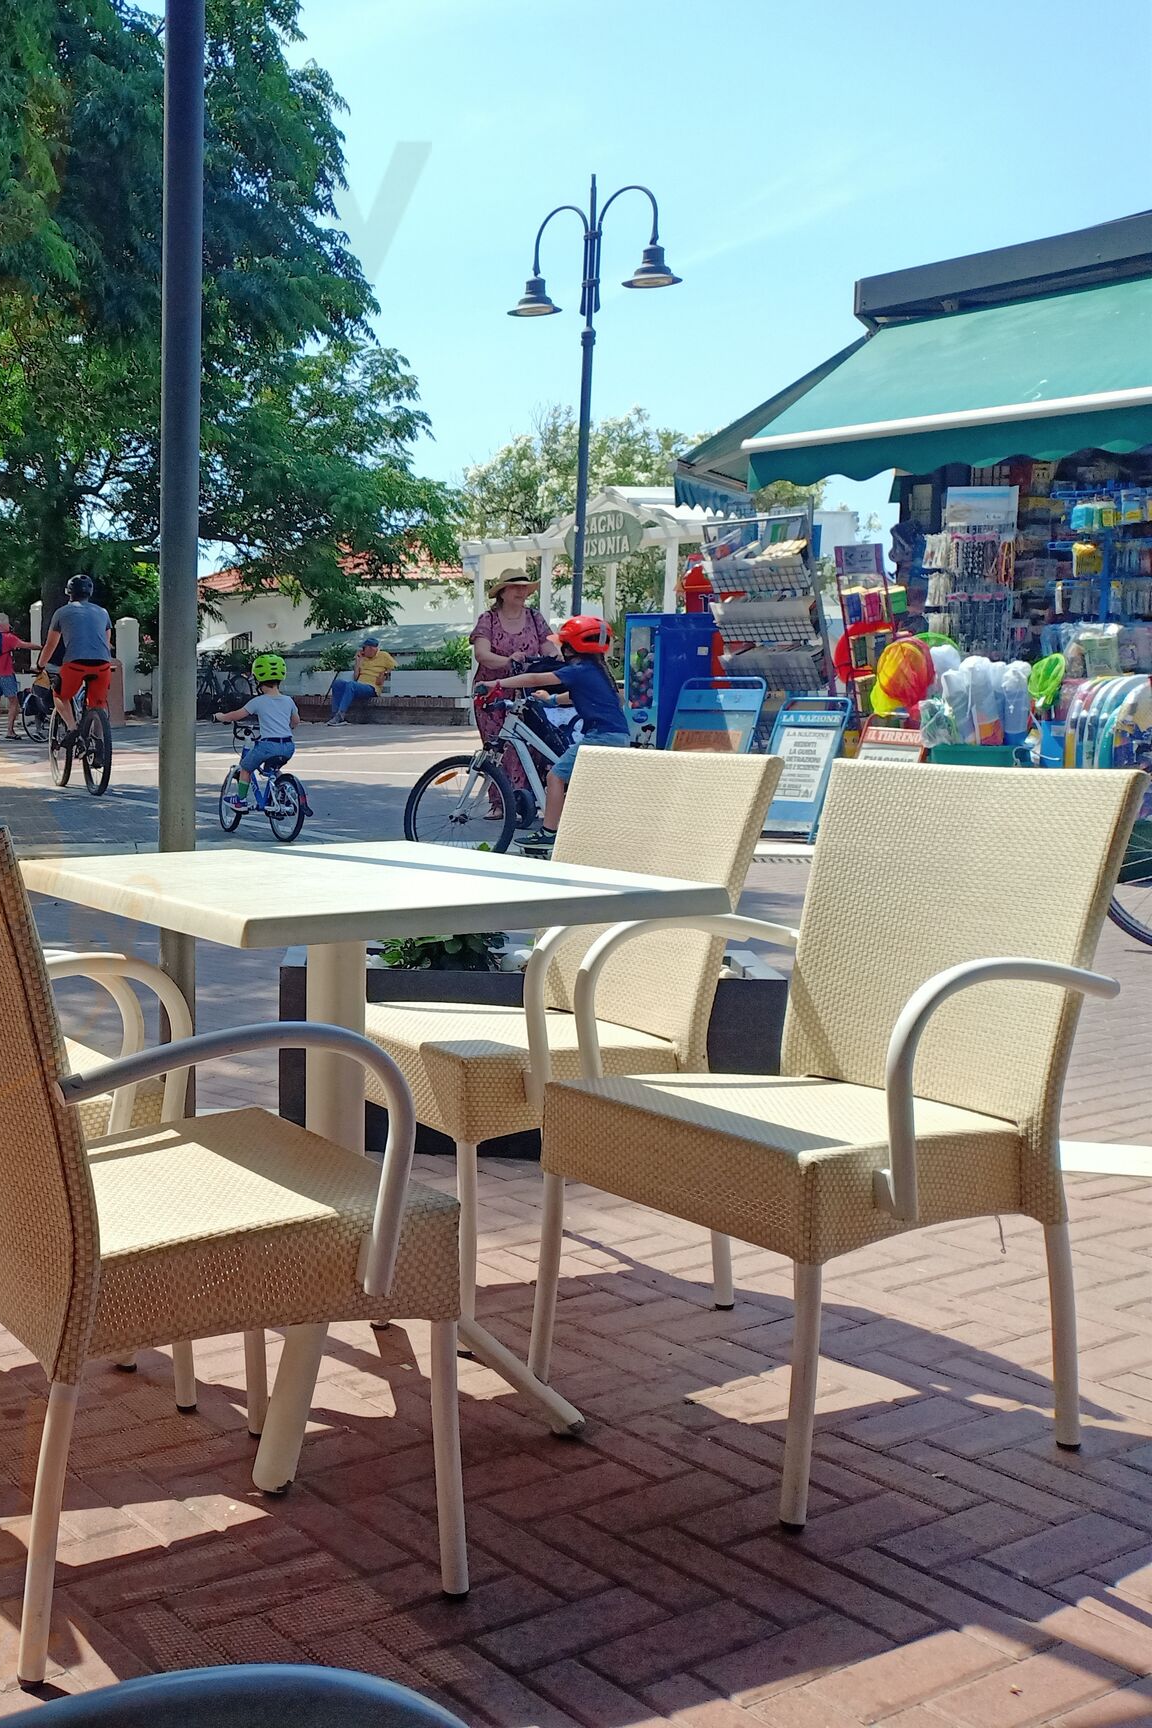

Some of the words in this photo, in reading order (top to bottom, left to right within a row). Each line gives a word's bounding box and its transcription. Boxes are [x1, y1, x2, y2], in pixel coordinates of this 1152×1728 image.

[584, 535, 629, 558] USONIA
[782, 714, 794, 723] LA
[798, 714, 841, 723] NAZIONE
[867, 730, 877, 741] IL
[878, 731, 921, 743] TIRRENO
